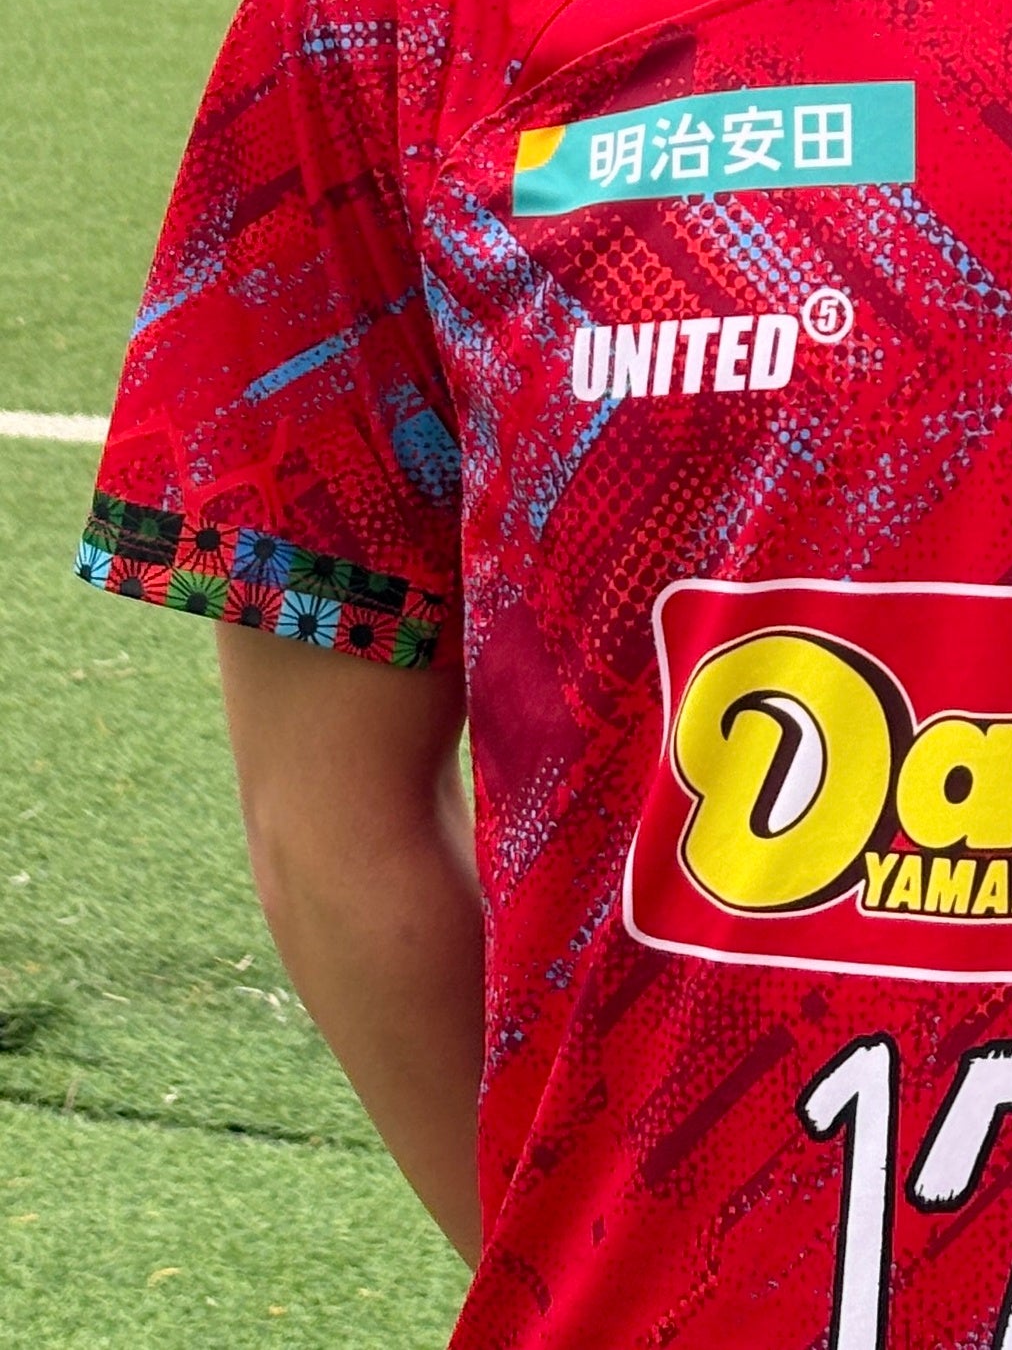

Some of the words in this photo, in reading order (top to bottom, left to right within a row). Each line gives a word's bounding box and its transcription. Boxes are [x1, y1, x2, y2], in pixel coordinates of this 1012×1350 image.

[589, 104, 853, 187] 明治安田
[571, 313, 800, 402] UNITED
